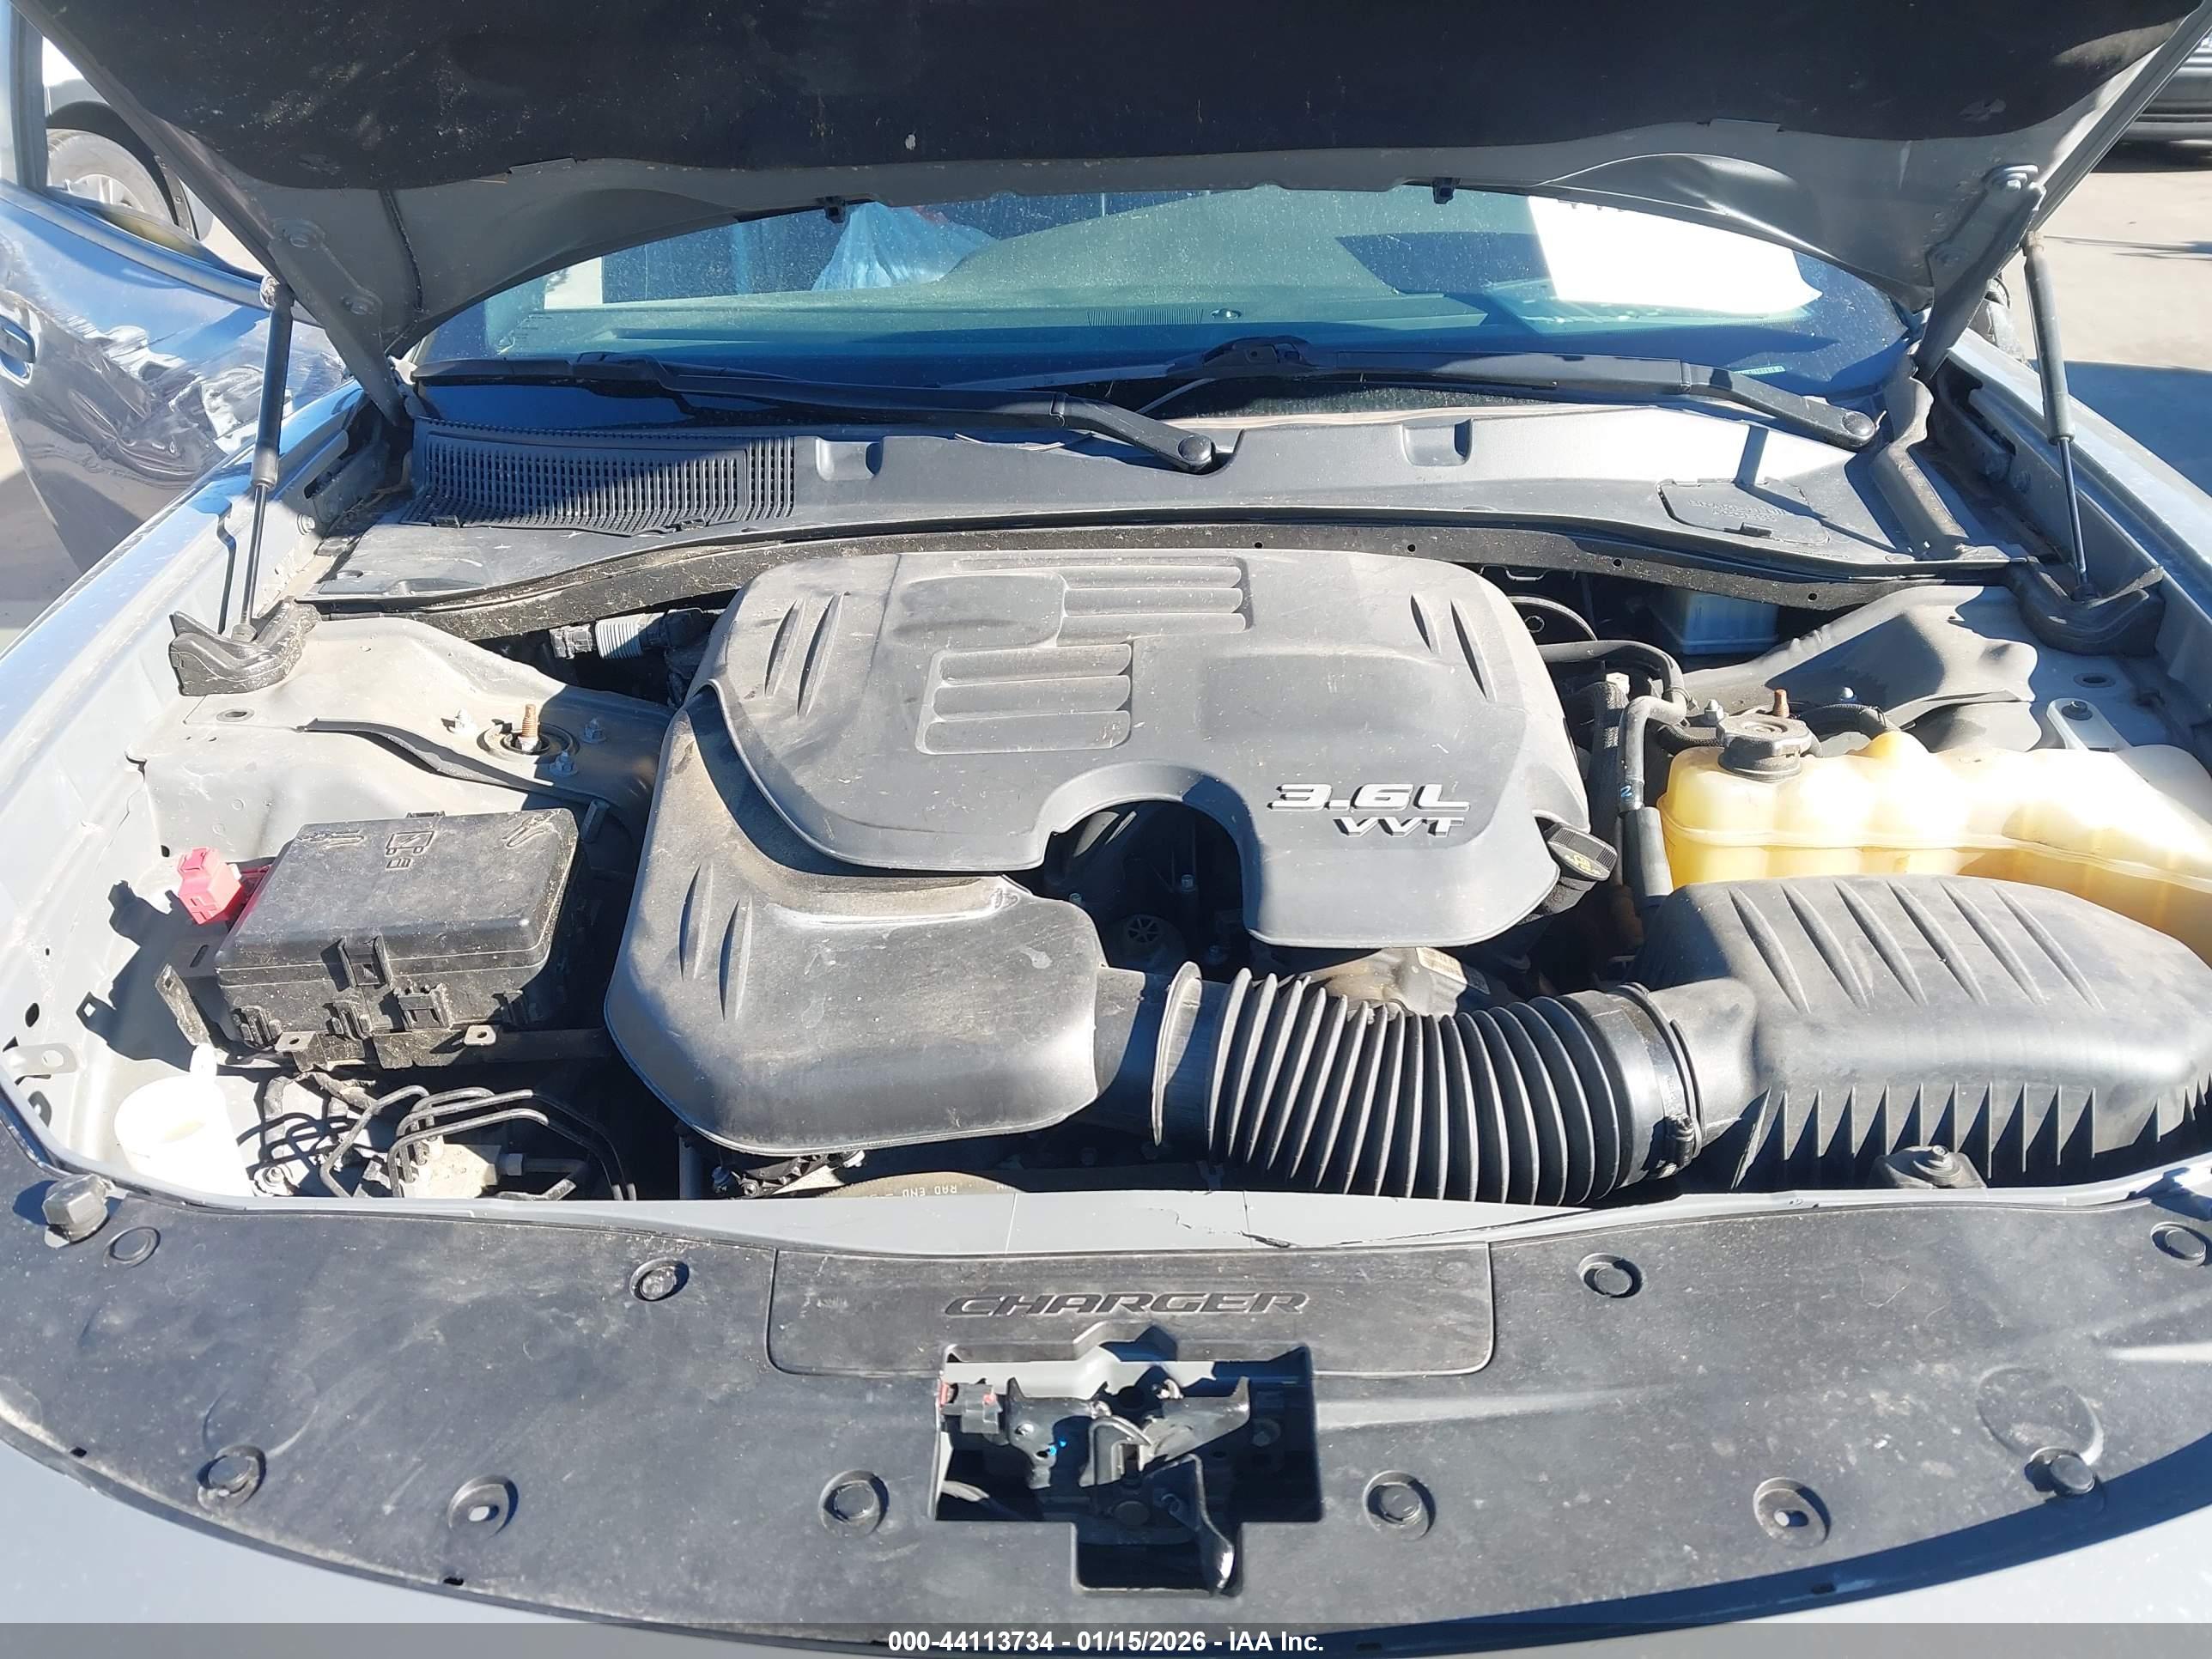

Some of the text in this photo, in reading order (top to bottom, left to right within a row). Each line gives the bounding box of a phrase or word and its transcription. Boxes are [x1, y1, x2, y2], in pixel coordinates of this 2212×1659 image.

[1267, 783, 1469, 811] 3.6L
[1333, 817, 1464, 836] VVT
[902, 1188, 926, 1198] END
[933, 1183, 957, 1194] RAD
[945, 1291, 1310, 1316] CHARGER
